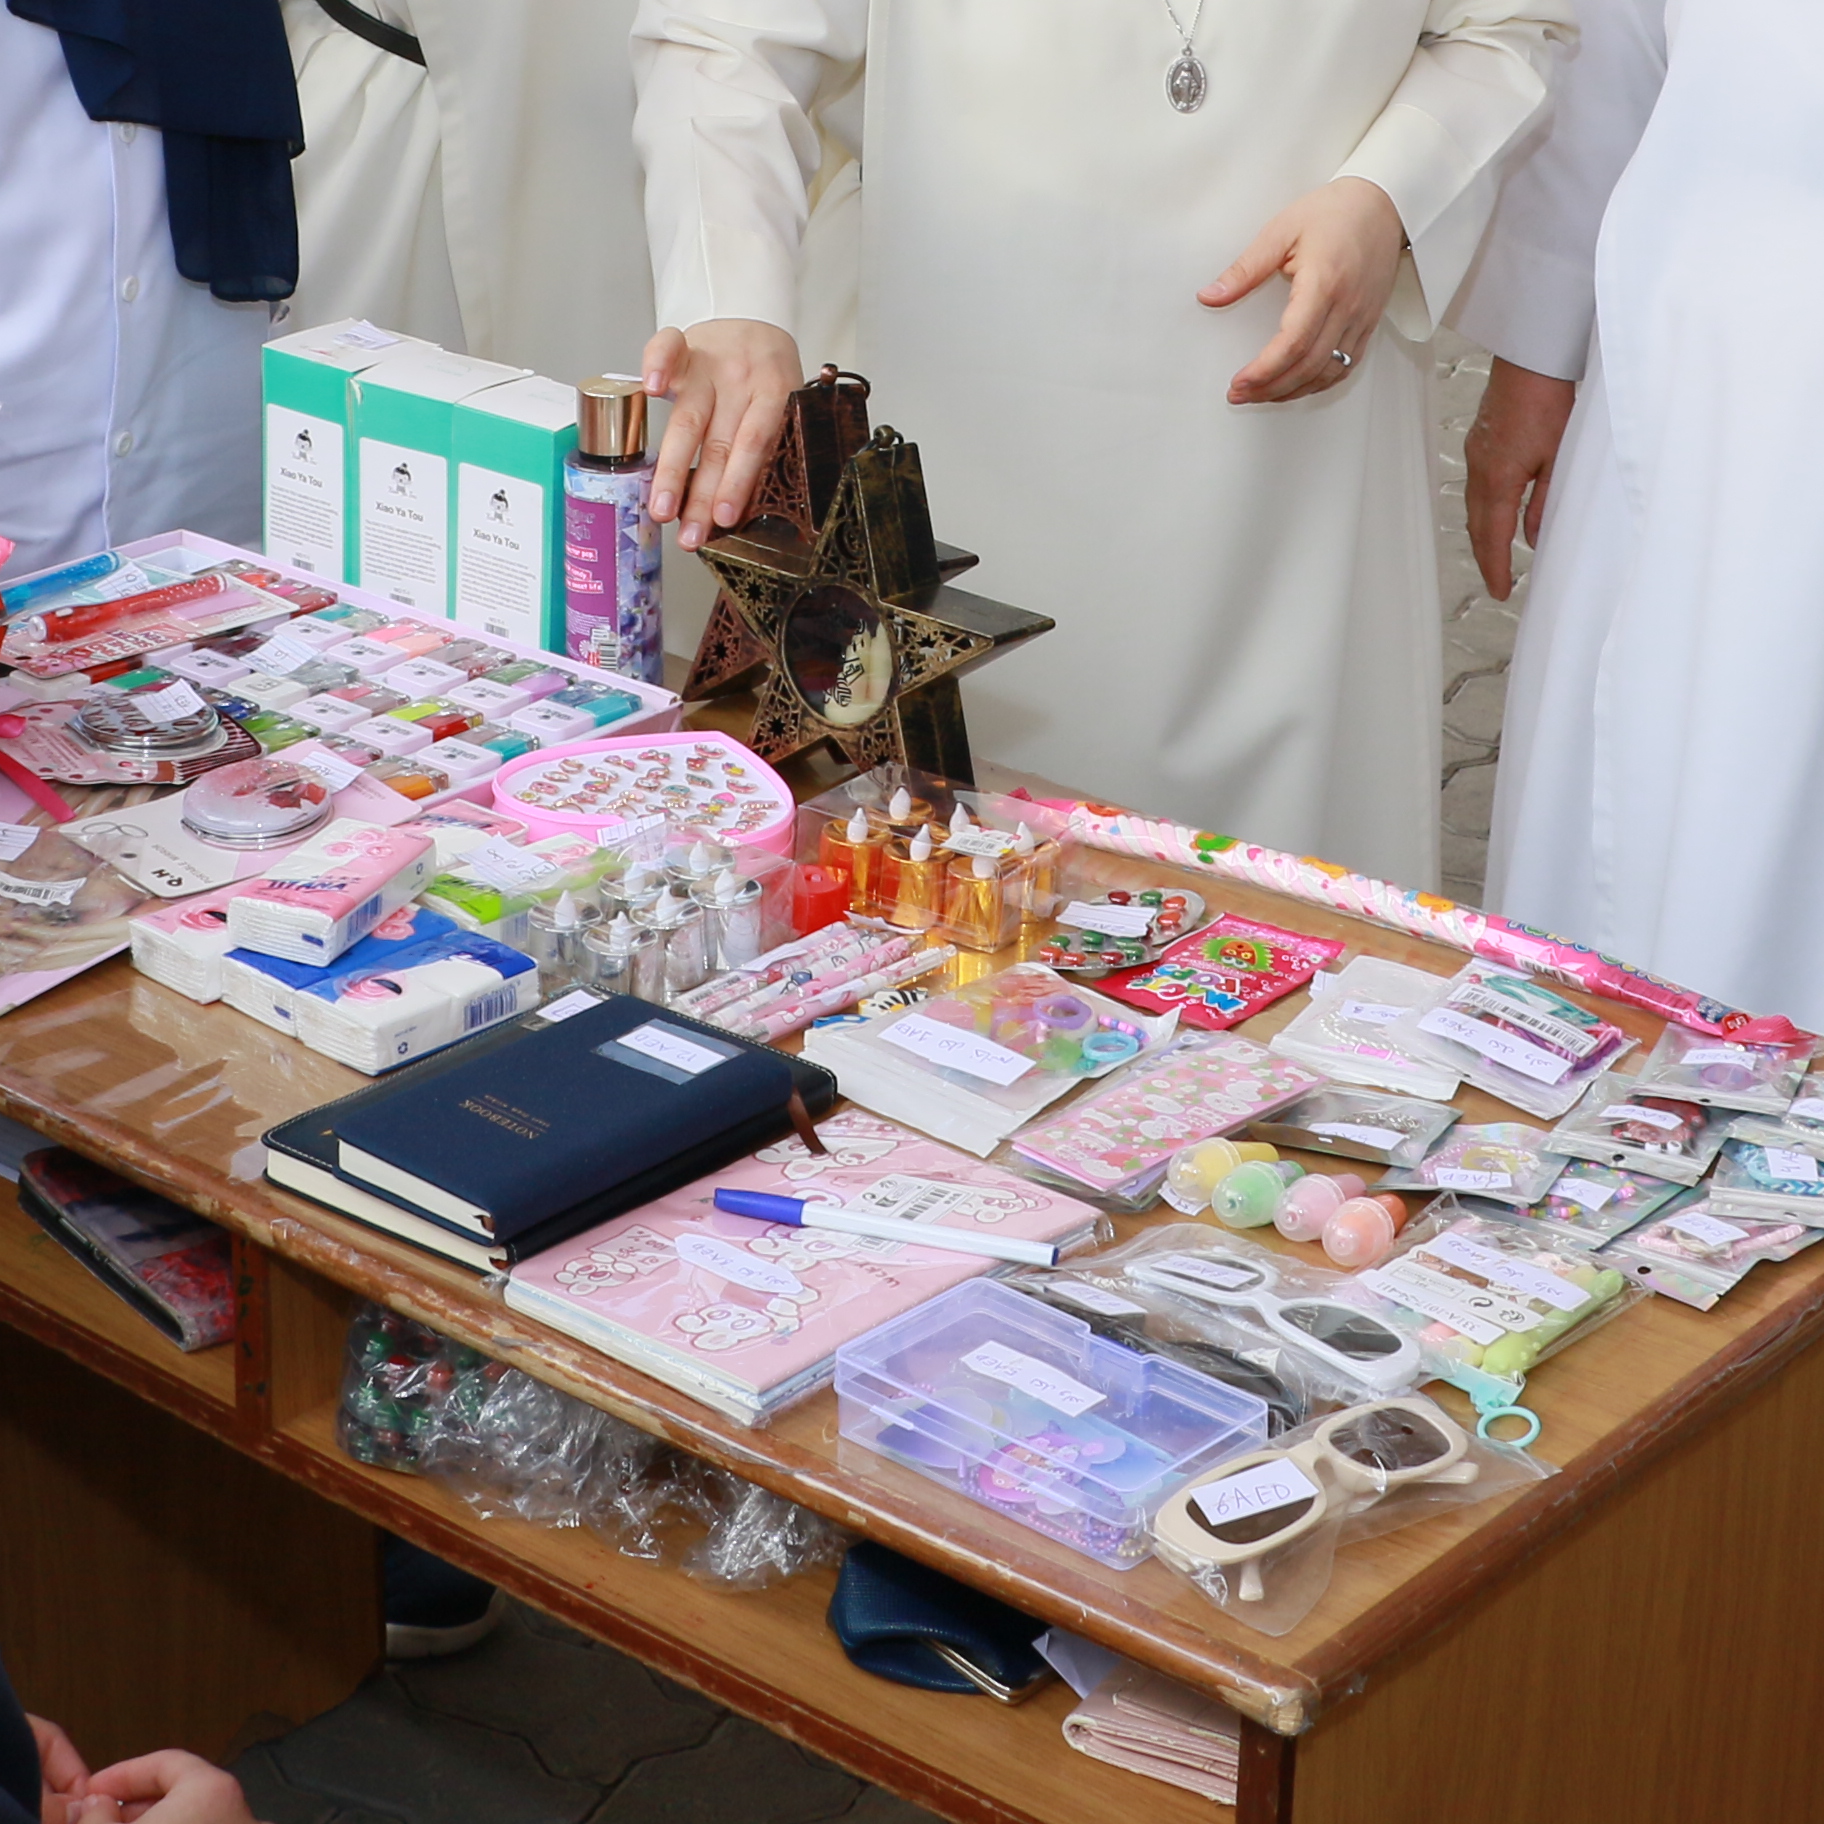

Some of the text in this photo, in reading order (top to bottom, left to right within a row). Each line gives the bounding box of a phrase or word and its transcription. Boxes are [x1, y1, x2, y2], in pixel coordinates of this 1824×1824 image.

[280, 466, 323, 488] Xiao Ya Tou
[375, 501, 424, 522] Xiao Ya Tou
[473, 527, 520, 551] Xiao Ya Tou
[1125, 974, 1250, 1015] MAGIC
[1153, 963, 1241, 997] POPS
[459, 1099, 540, 1140] NOTEBOOK
[1216, 1483, 1292, 1516] 6AED
